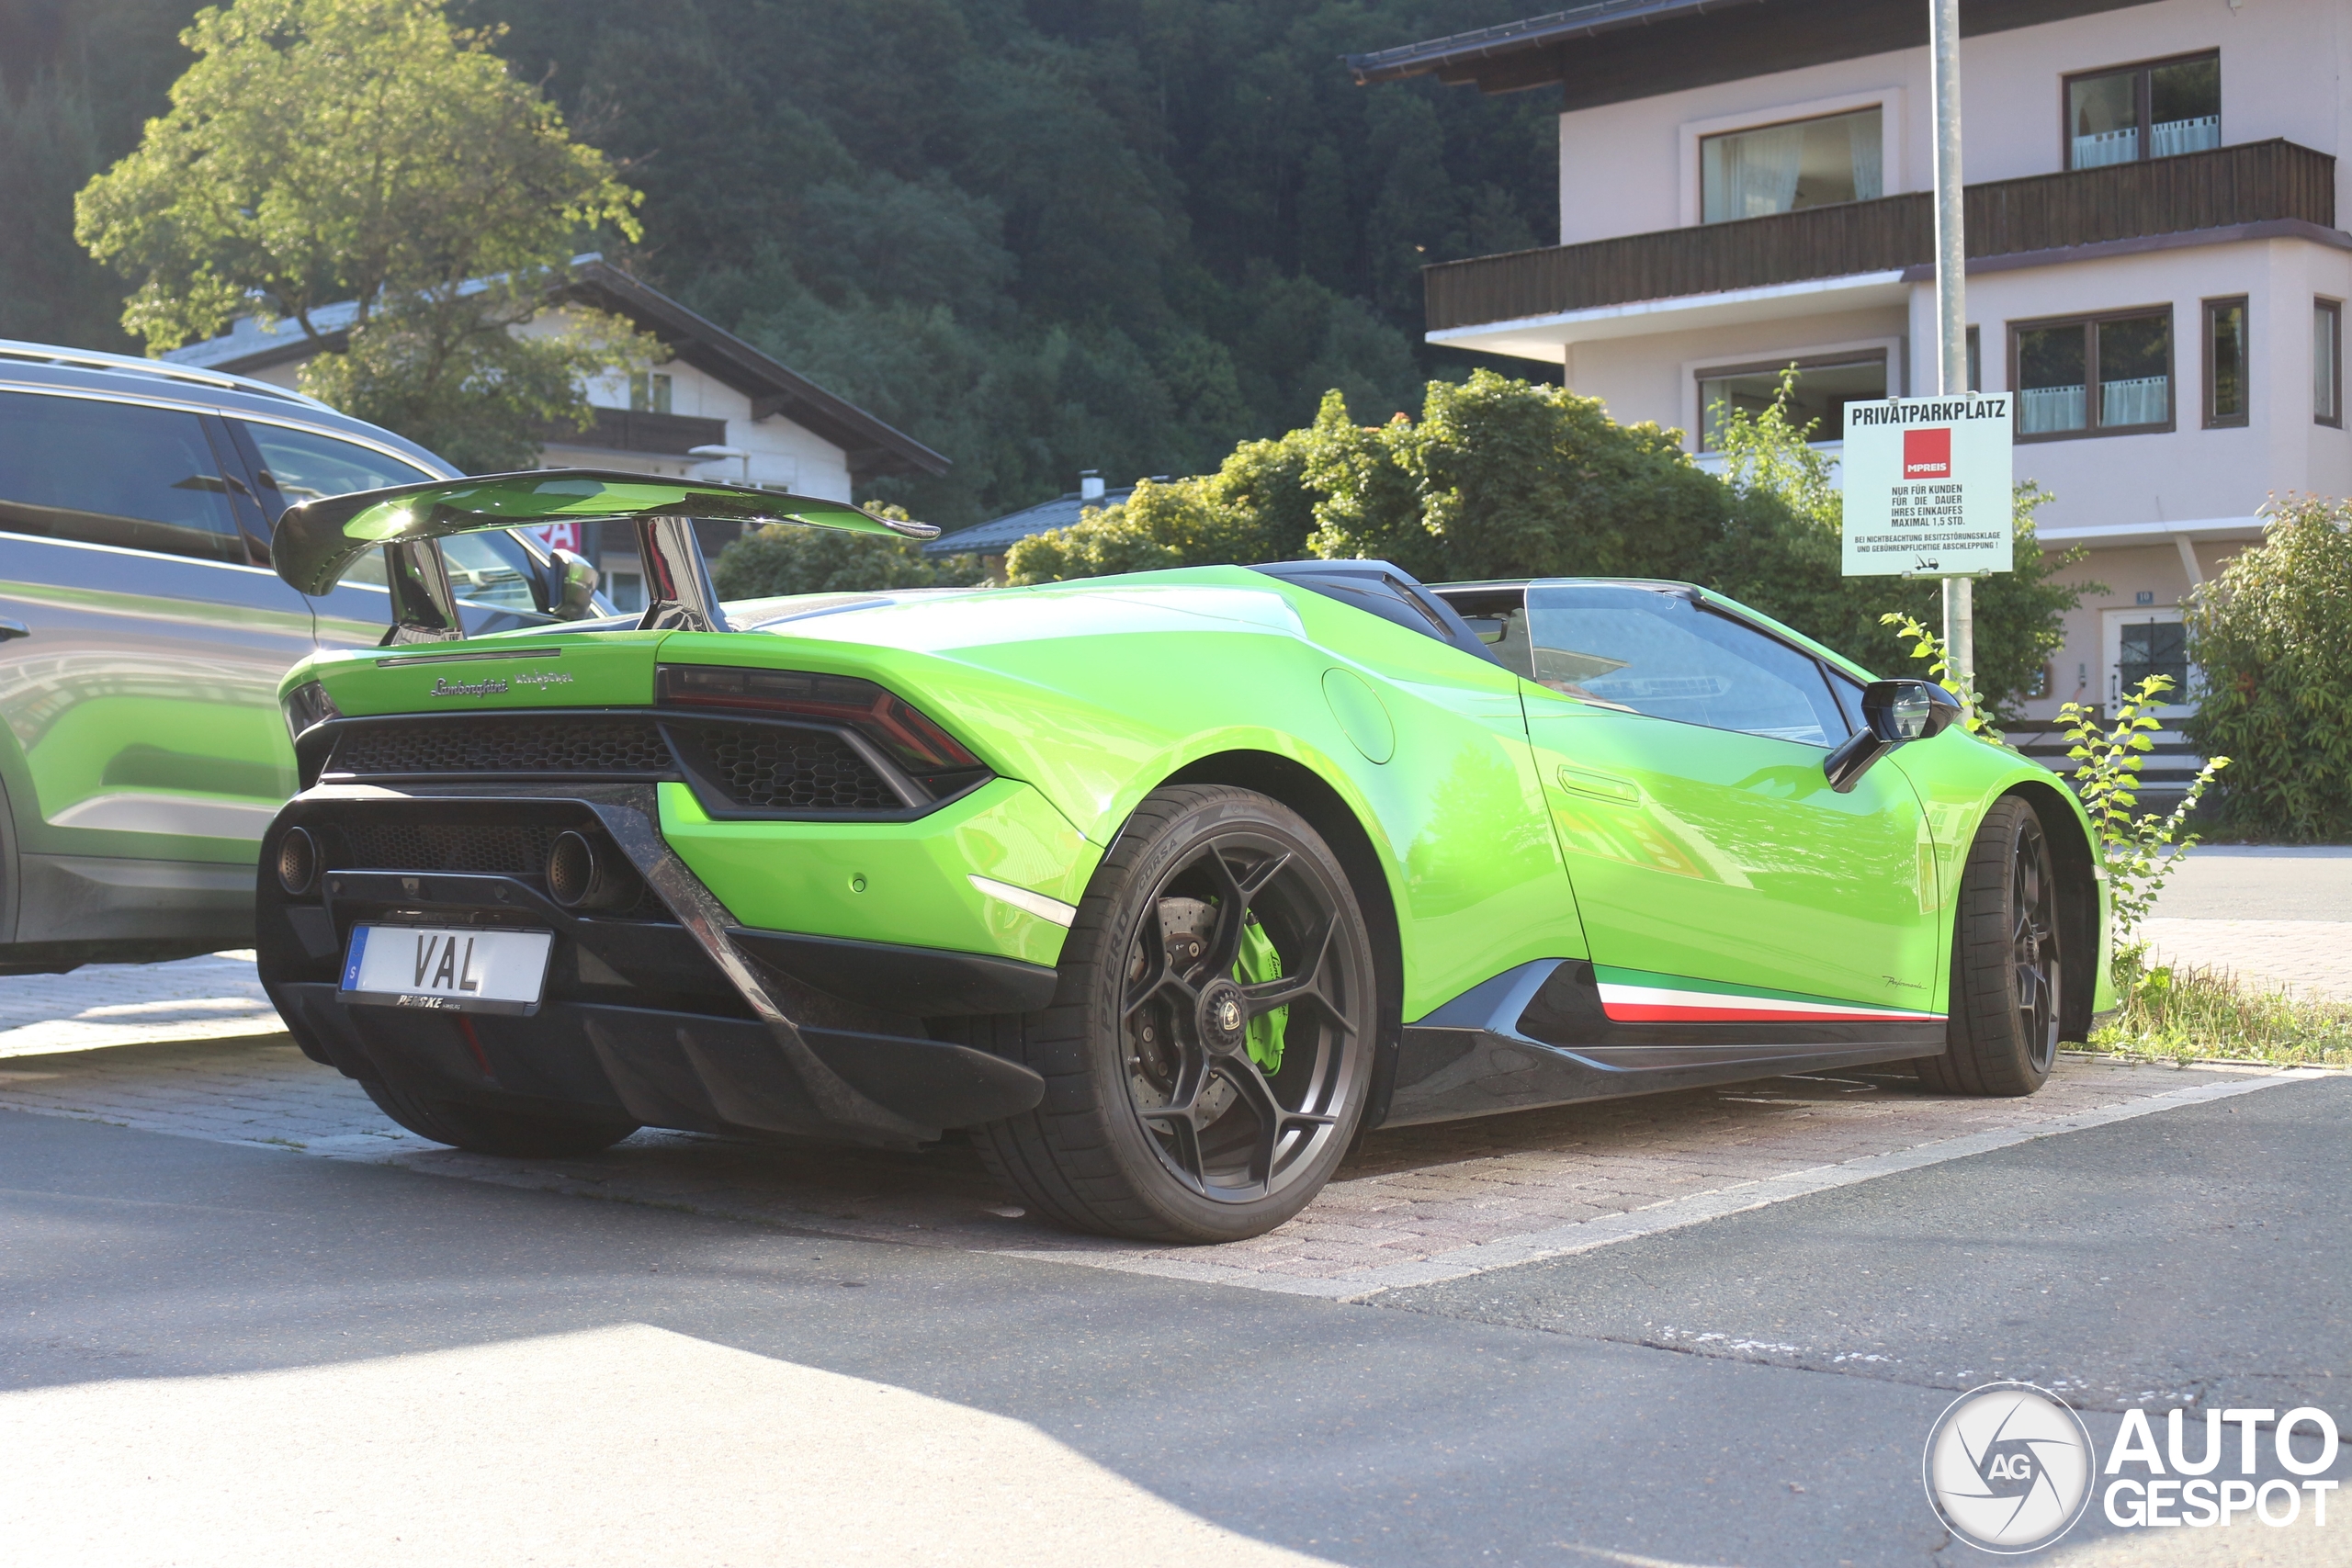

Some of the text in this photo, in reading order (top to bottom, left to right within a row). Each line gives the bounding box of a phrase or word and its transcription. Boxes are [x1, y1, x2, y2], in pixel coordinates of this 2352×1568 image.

[1852, 400, 2006, 426] PRIVATPARKPLATZ
[1907, 463, 1947, 472] MPREIS
[1892, 484, 1962, 496] NUR FÜR KUNDEN
[1892, 494, 1962, 506] FÜR DIE DAUER
[1891, 505, 1963, 517] IHRES EINKAUFES
[1891, 516, 1965, 528] MAXIMAL 1,5 STD.
[1855, 531, 2001, 544] BEI NICHTBEACHTUNG BESITZSTÖRUNGSKLAGE
[1857, 545, 1871, 553] UND
[1871, 543, 1940, 552] GEBÜHRENPFLICHTIGE
[1942, 541, 1994, 550] ABSCHLEPPUNG
[430, 677, 508, 698] Lamborghini
[1137, 837, 1178, 893] CORSA
[414, 935, 477, 990] VAL
[349, 966, 356, 979] S
[396, 995, 444, 1009] PENSKE
